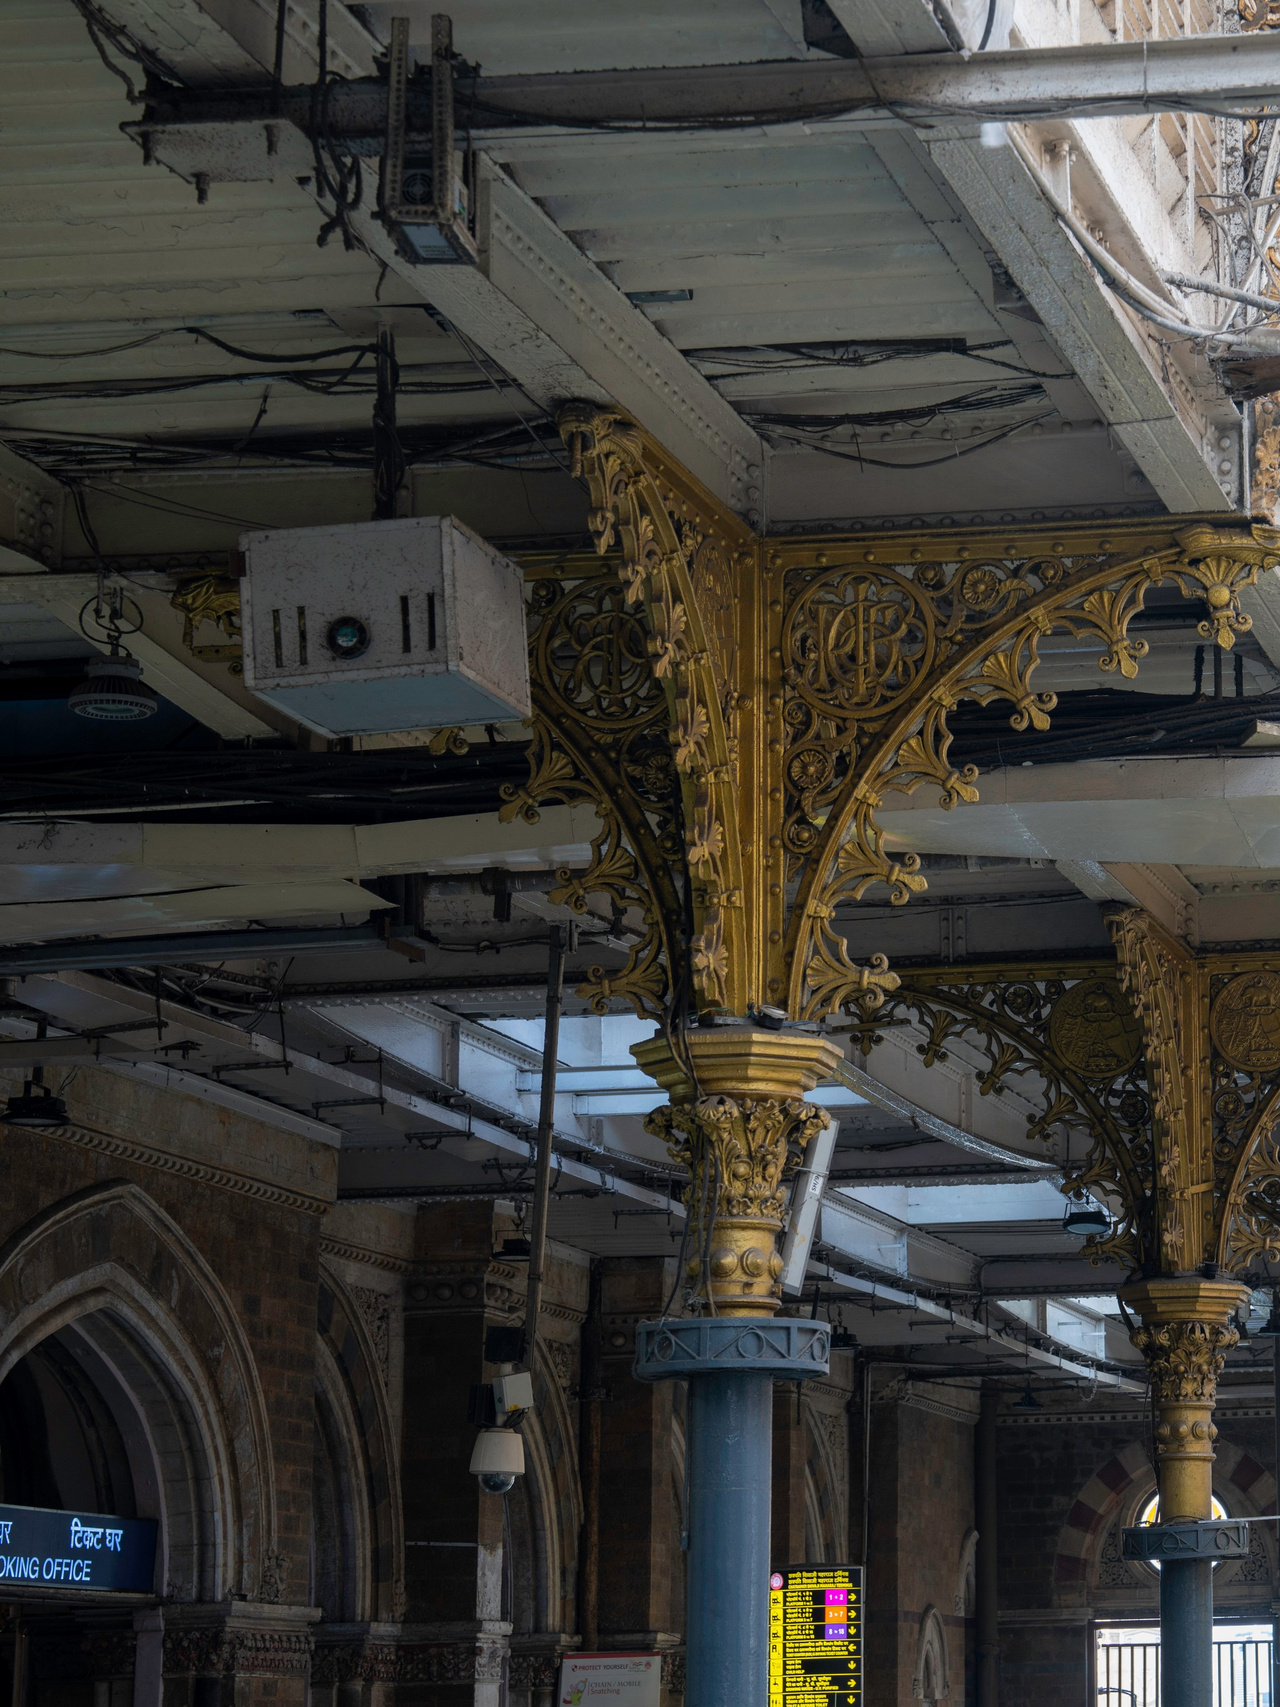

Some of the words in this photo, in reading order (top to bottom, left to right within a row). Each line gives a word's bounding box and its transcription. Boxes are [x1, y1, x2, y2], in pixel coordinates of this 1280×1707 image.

[70, 1517, 103, 1550] टिकट
[105, 1528, 123, 1552] घर
[42, 1558, 92, 1582] OFFICE
